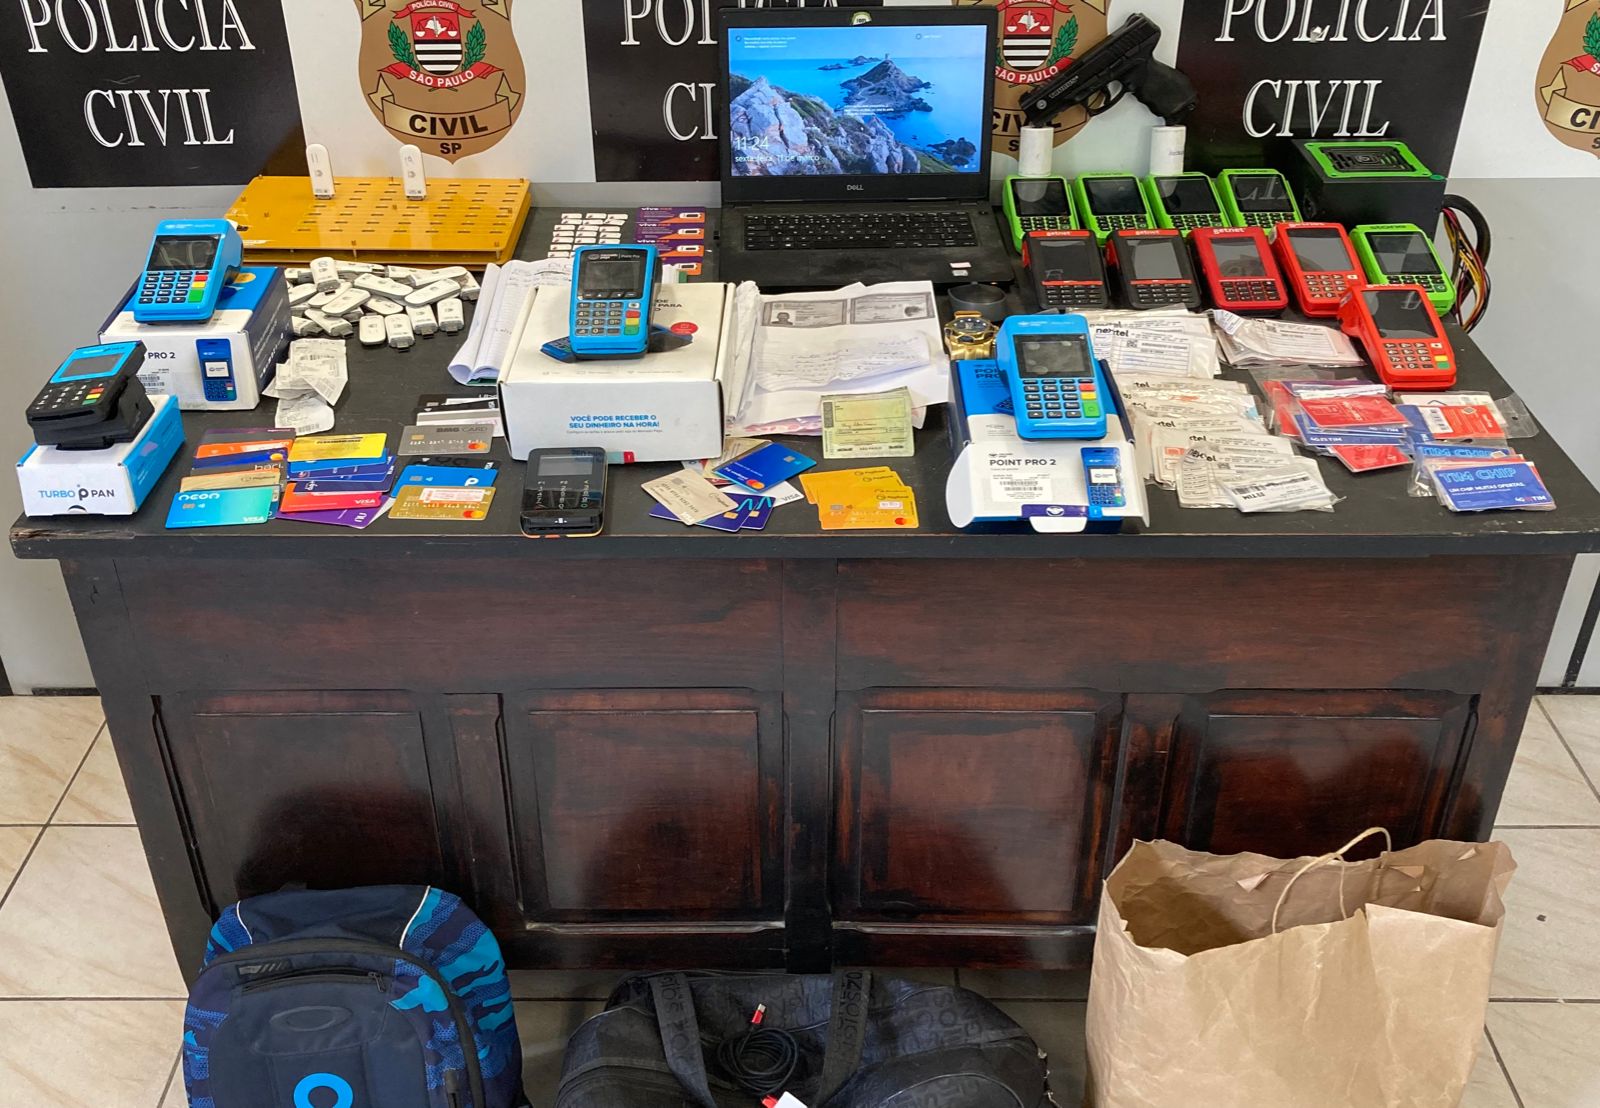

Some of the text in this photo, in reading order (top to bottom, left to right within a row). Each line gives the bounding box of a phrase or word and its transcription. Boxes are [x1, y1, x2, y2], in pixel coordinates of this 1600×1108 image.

[437, 70, 475, 87] PAULO
[1019, 65, 1059, 84] PAULO
[1242, 79, 1390, 138] CIVIL
[83, 88, 235, 148] CIVIL
[408, 113, 489, 137] CIVIL
[439, 142, 462, 155] SP
[570, 414, 591, 422] VOCÊ
[1025, 458, 1048, 466] PRO
[1049, 458, 1057, 466] 2
[1439, 467, 1517, 483] TIM CHIP
[38, 489, 76, 498] TURBO
[91, 489, 115, 498] PAN
[178, 492, 221, 502] neon
[781, 493, 801, 502] VISA
